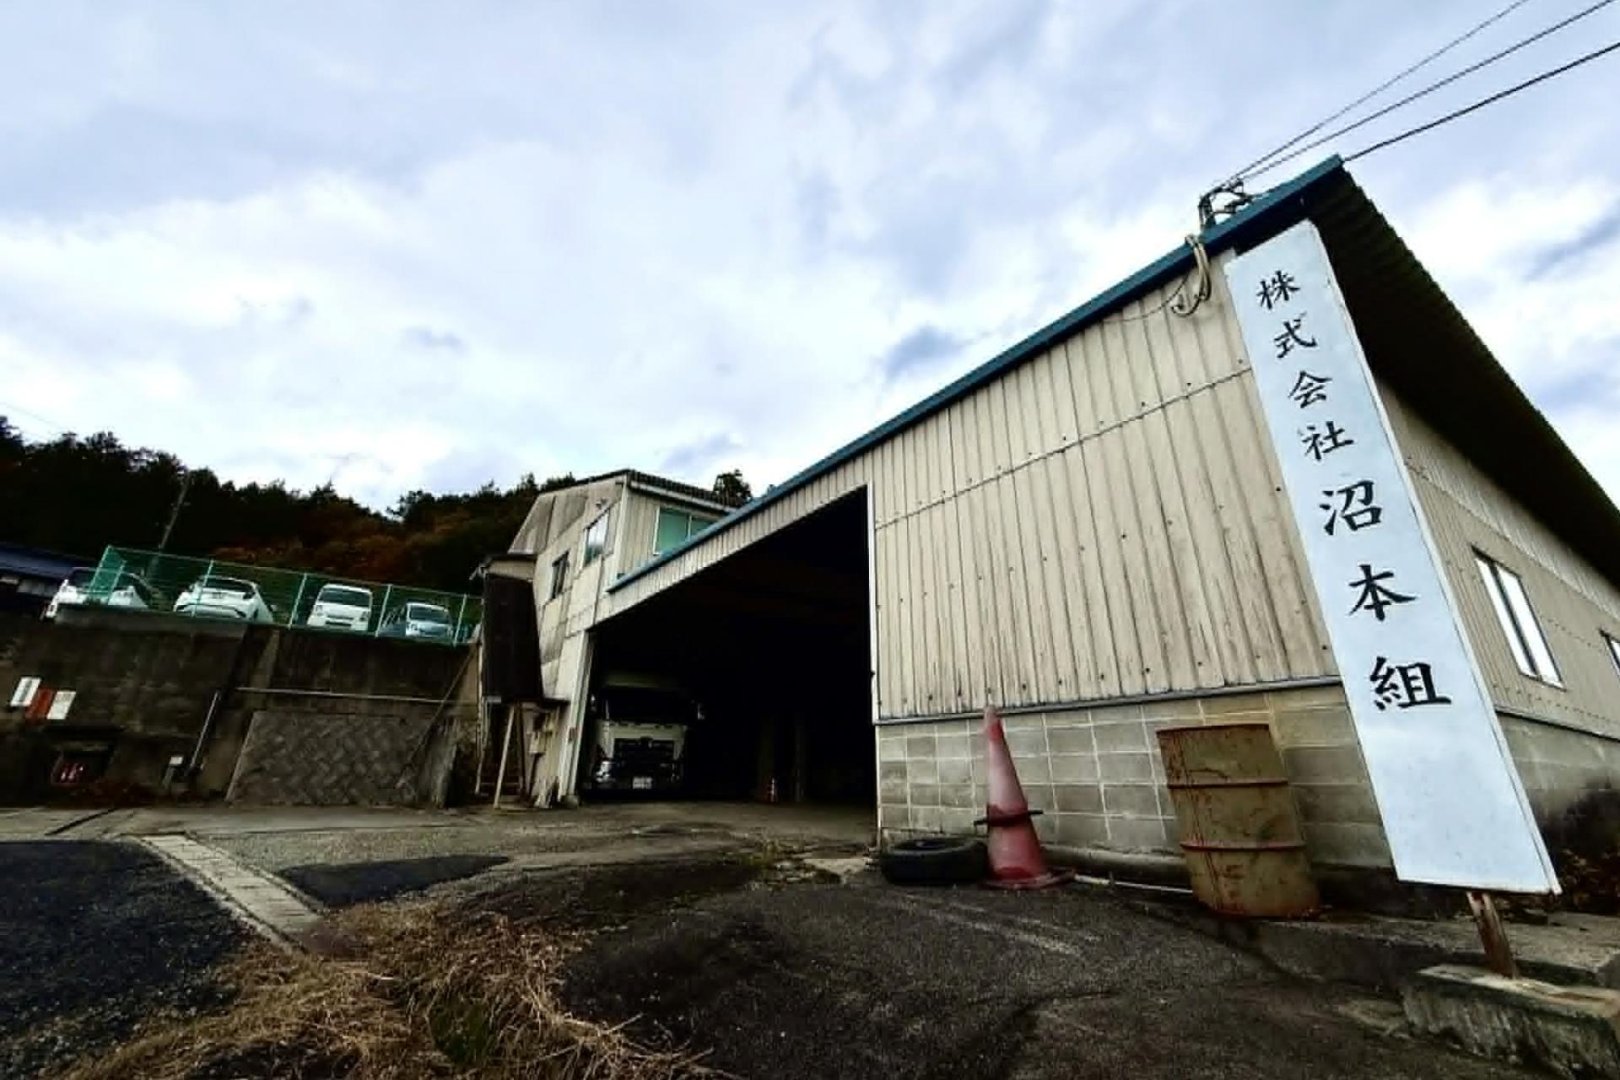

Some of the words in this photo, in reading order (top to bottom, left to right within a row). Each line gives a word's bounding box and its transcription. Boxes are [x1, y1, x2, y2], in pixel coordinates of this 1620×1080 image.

[1256, 269, 1452, 710] 株式会社沼本組
